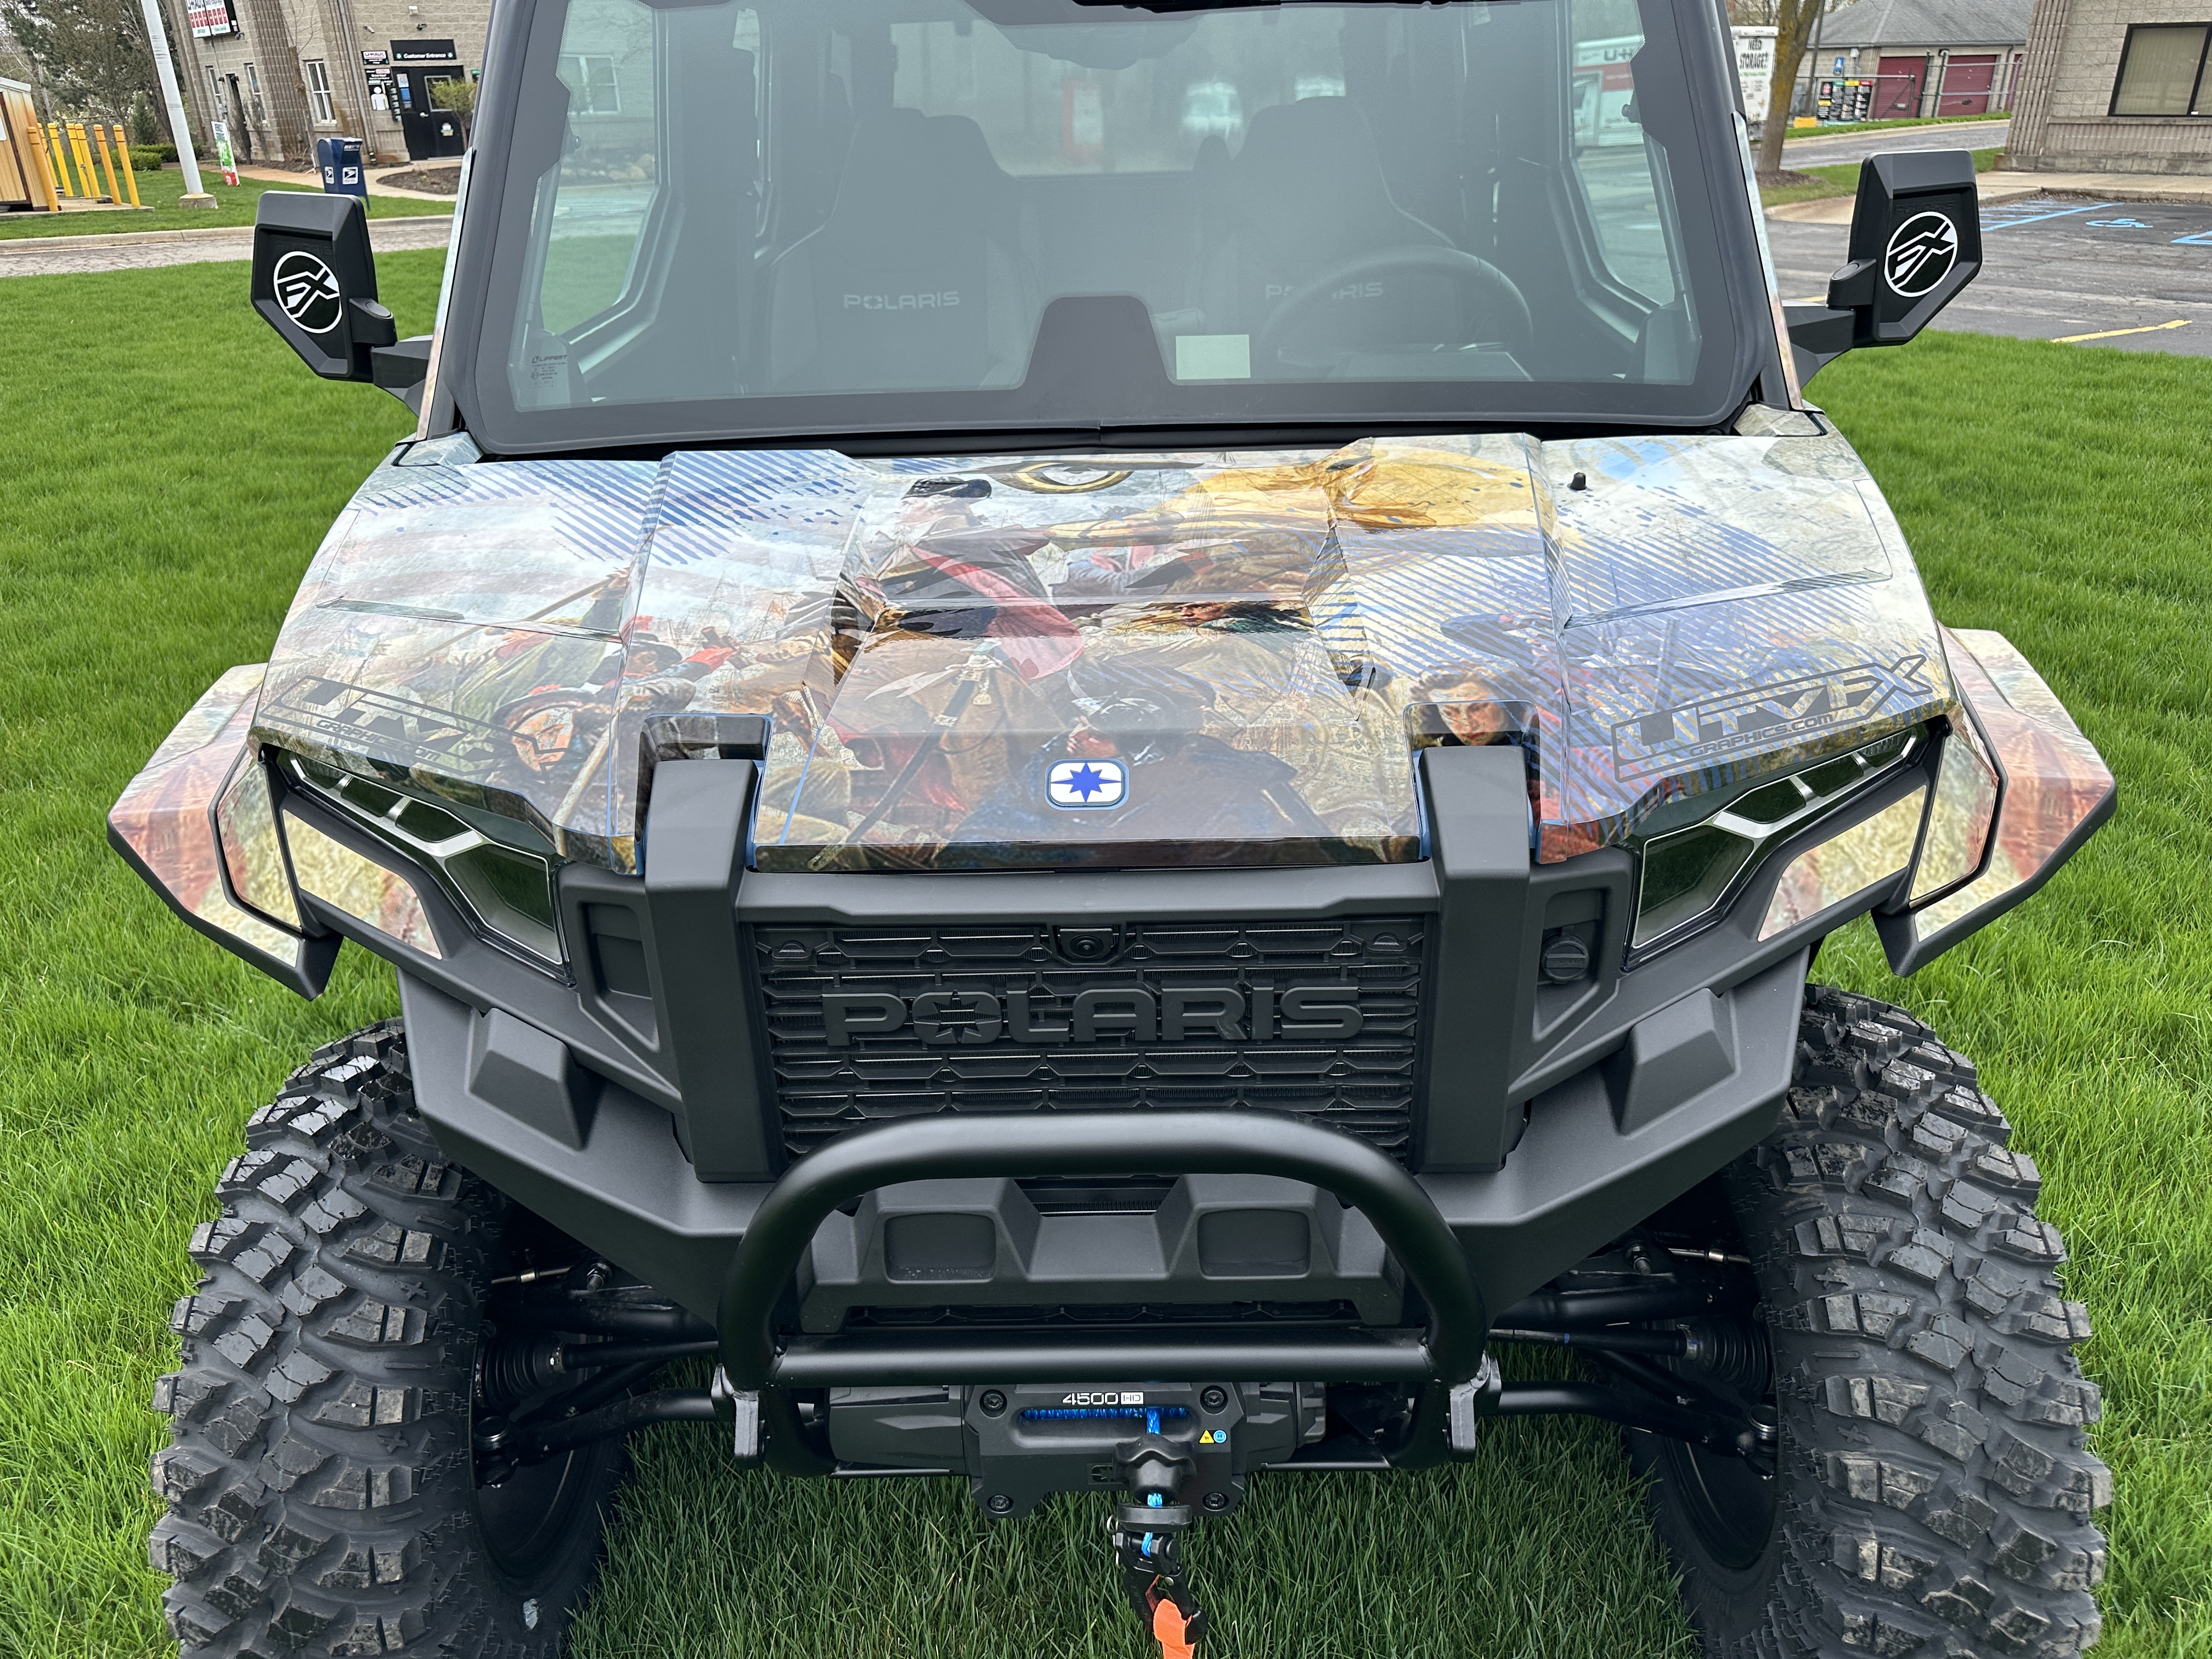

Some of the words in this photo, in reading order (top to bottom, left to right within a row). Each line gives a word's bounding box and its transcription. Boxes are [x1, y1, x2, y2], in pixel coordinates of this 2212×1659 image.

[1748, 39, 1762, 50] NEED
[1739, 52, 1768, 69] STORAGE?
[1266, 283, 1383, 299] PRIS
[844, 291, 960, 309] POLARIS
[821, 981, 1365, 1047] POLARIS
[1062, 1392, 1118, 1406] 4500
[1122, 1393, 1142, 1403] HD
